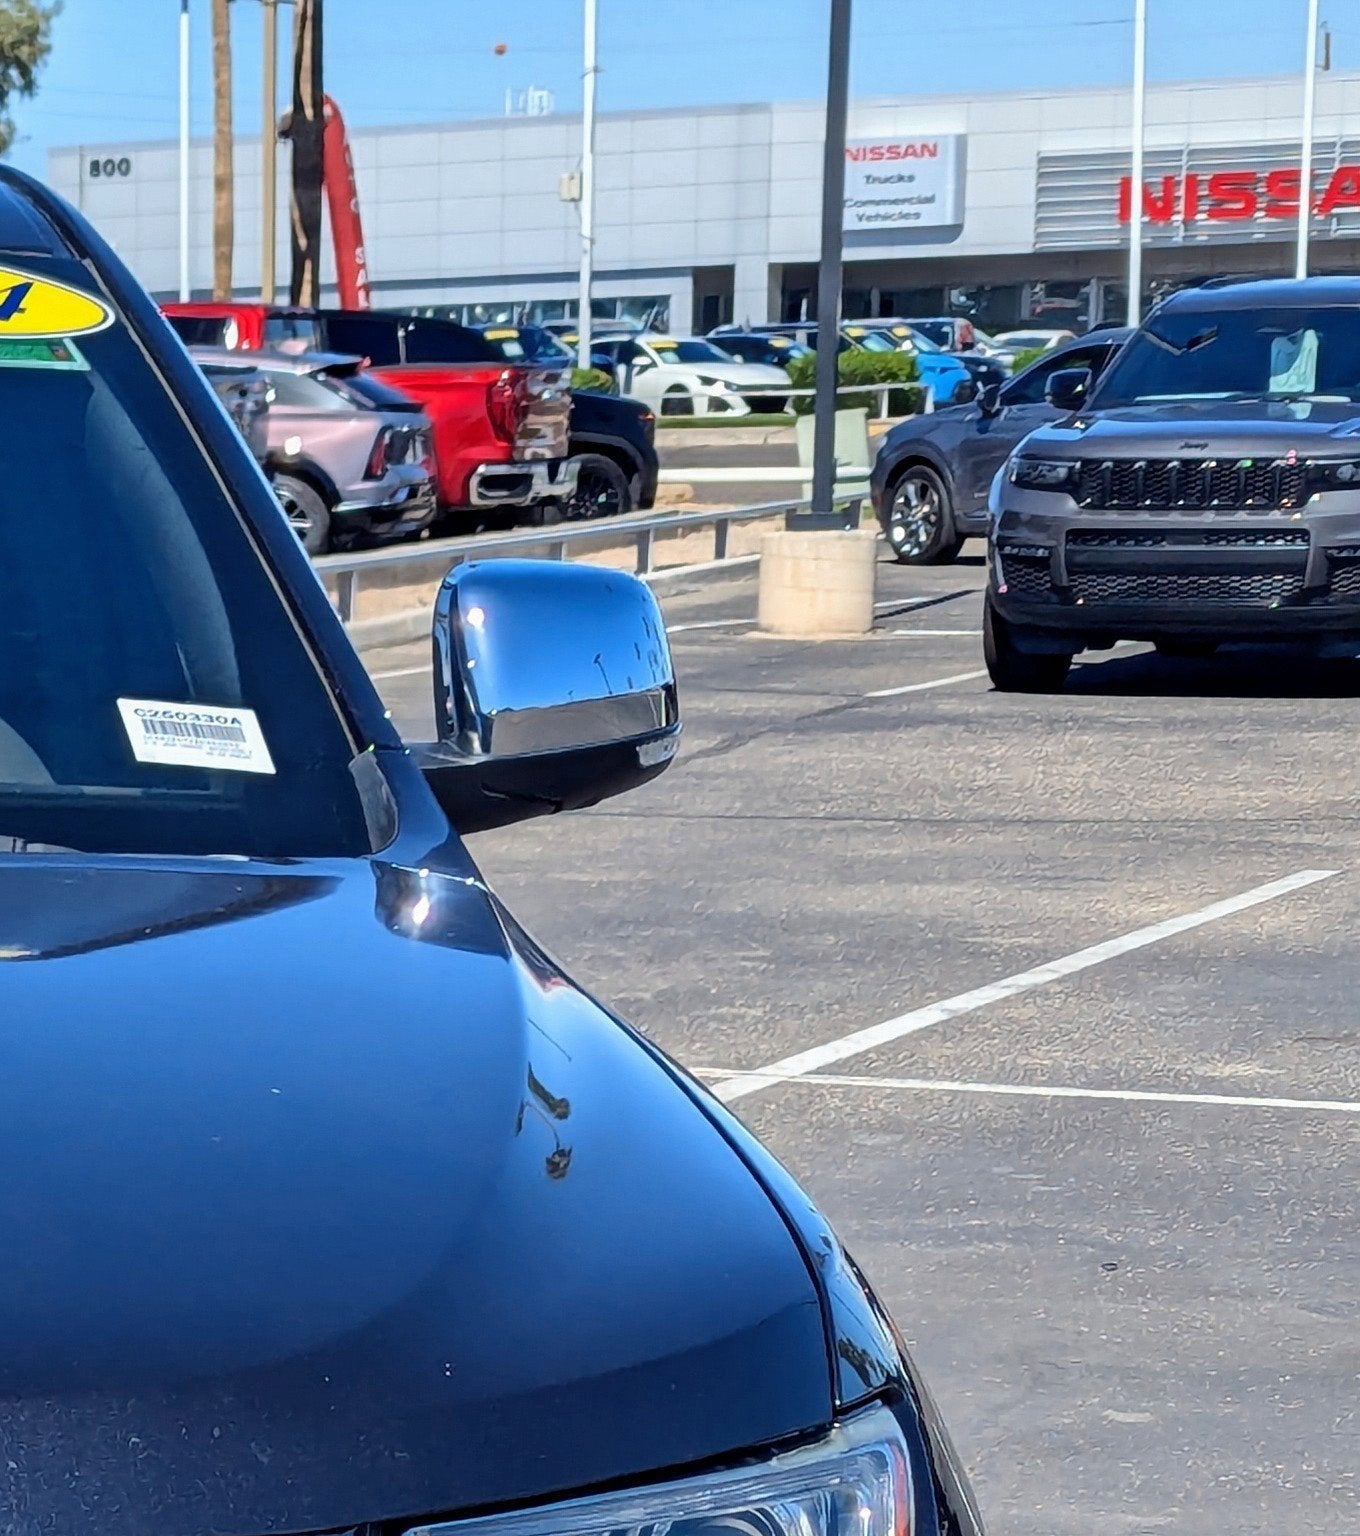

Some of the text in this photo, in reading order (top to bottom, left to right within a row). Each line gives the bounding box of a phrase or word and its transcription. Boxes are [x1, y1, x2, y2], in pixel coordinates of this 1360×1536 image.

[844, 142, 939, 162] NISSAN
[89, 157, 131, 178] 800
[863, 173, 916, 185] Trucks
[855, 210, 922, 223] Vehicles
